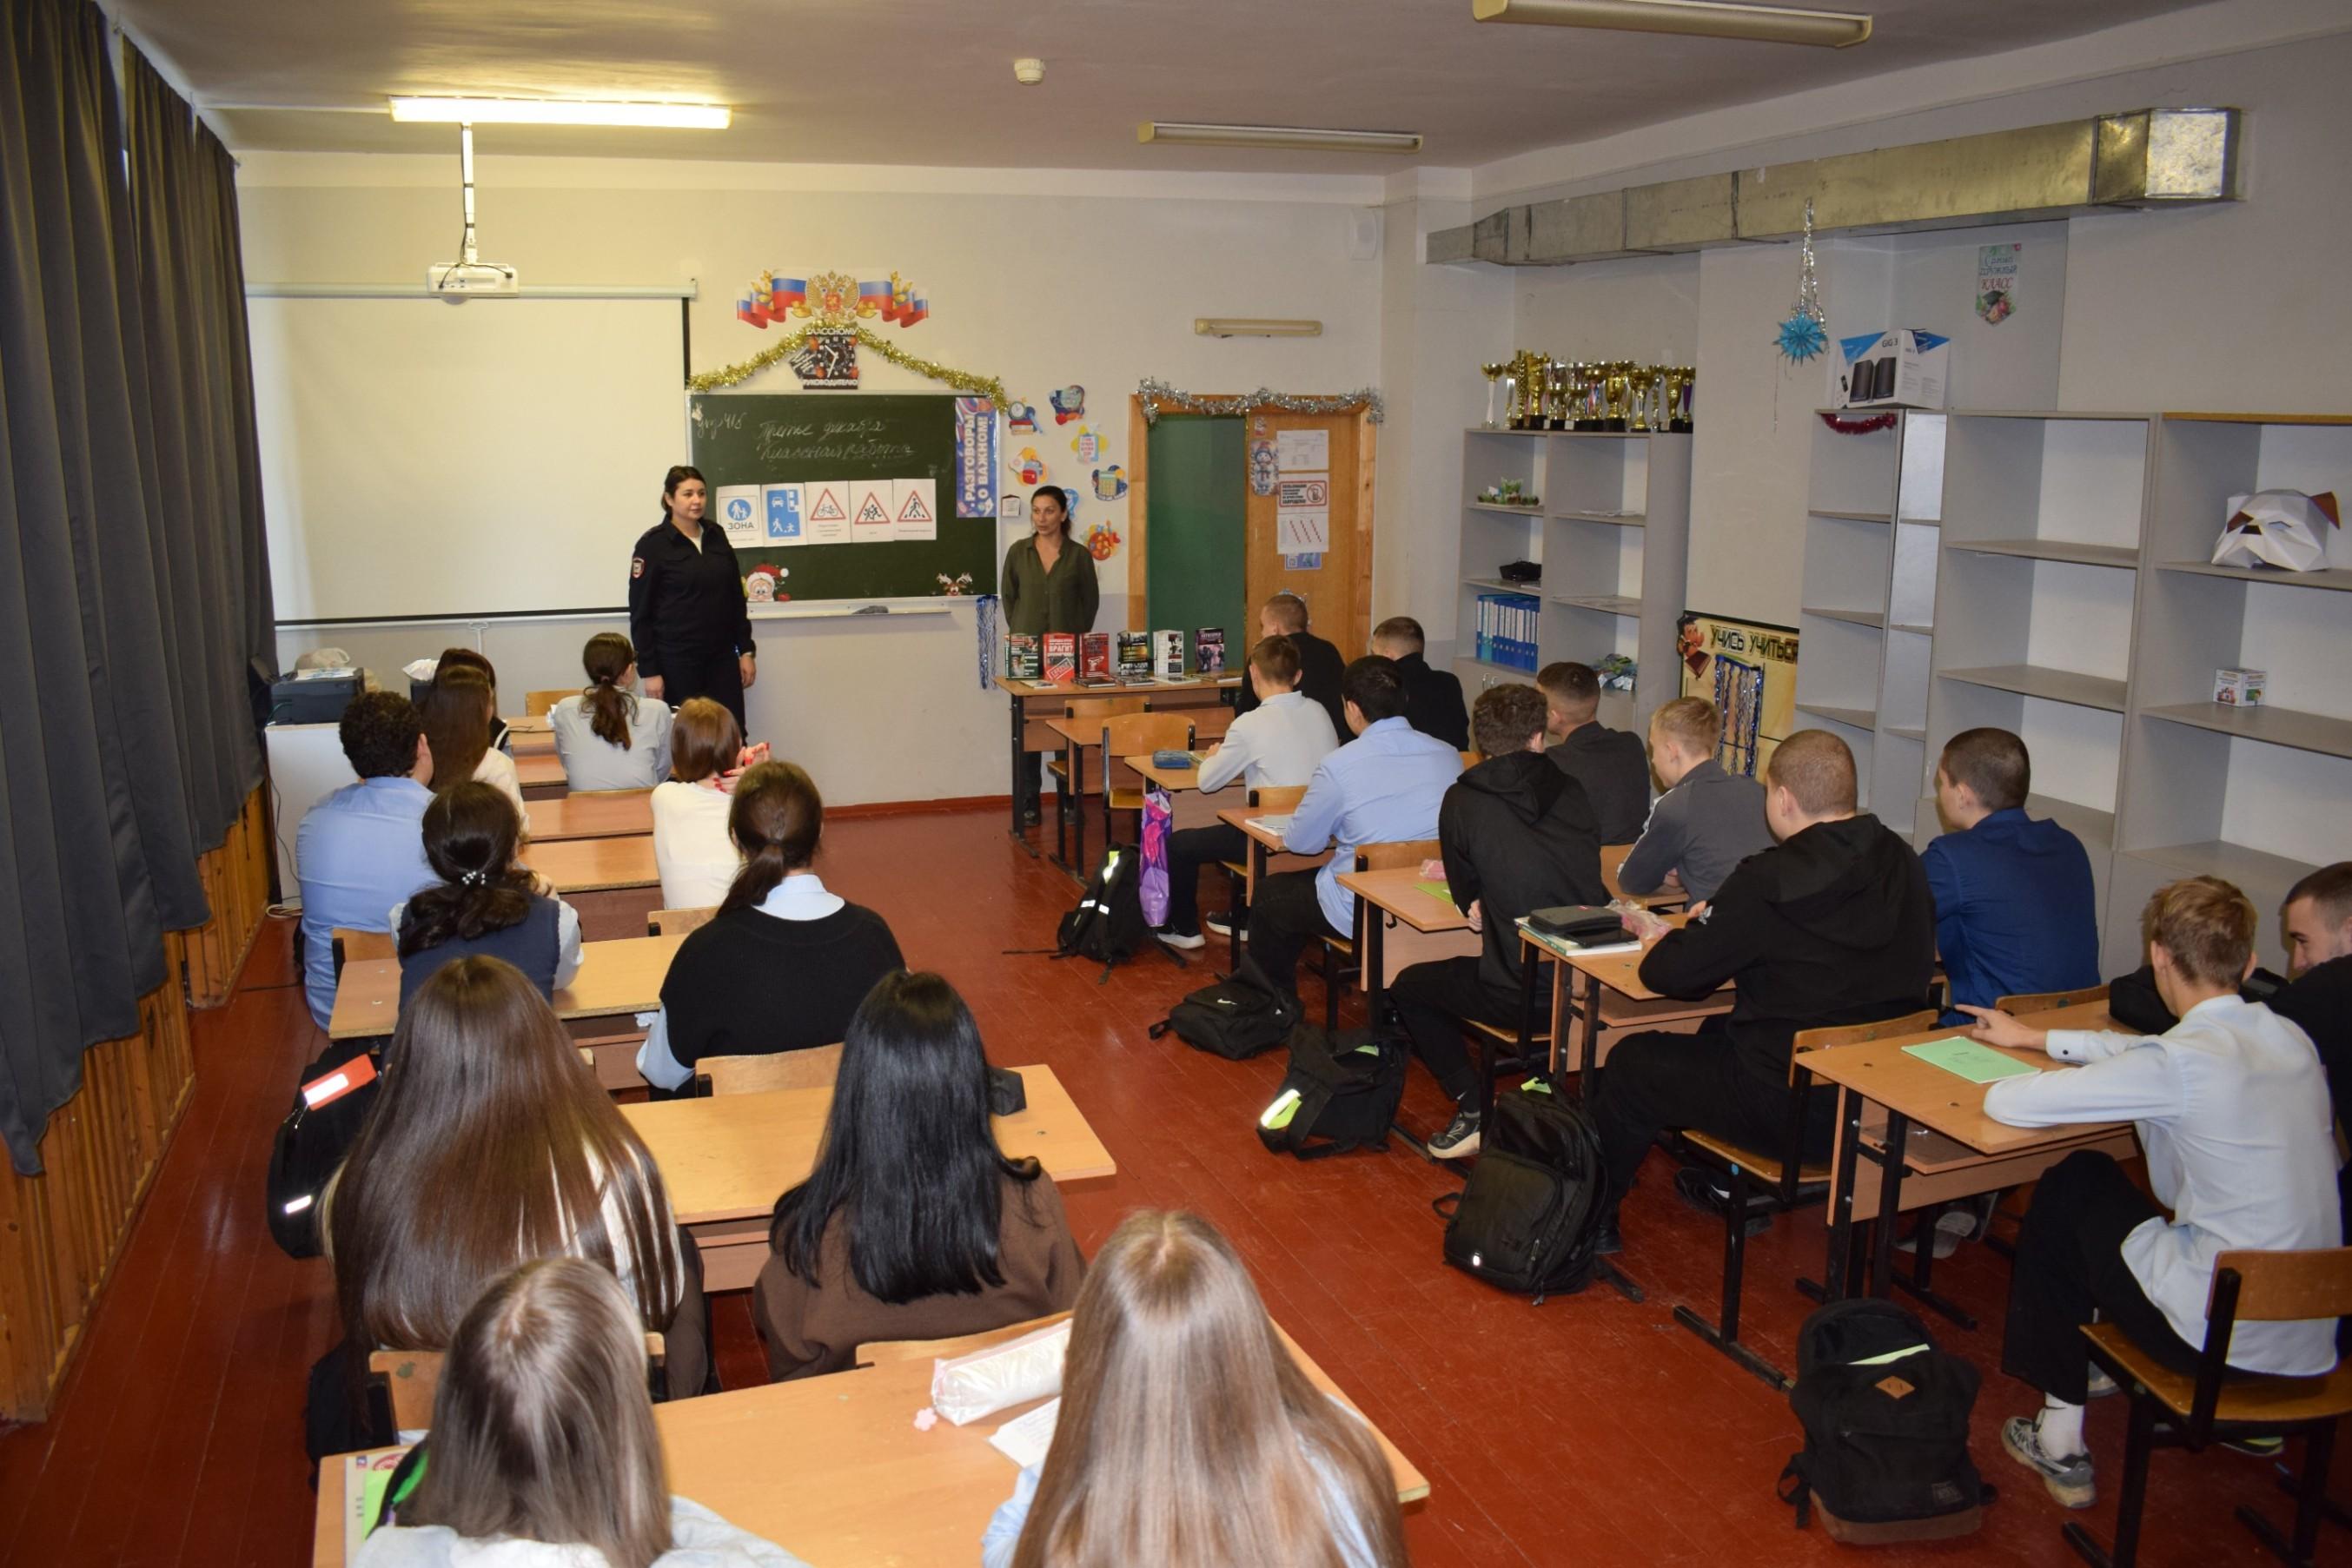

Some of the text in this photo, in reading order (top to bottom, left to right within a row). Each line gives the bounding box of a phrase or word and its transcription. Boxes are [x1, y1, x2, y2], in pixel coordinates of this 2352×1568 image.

[964, 414, 975, 501] РАЗГОВОРЫ
[977, 416, 989, 500] О ВАЖНОМ!
[727, 521, 754, 531] ЗОНА
[1709, 624, 1745, 654] УЧИСЬ
